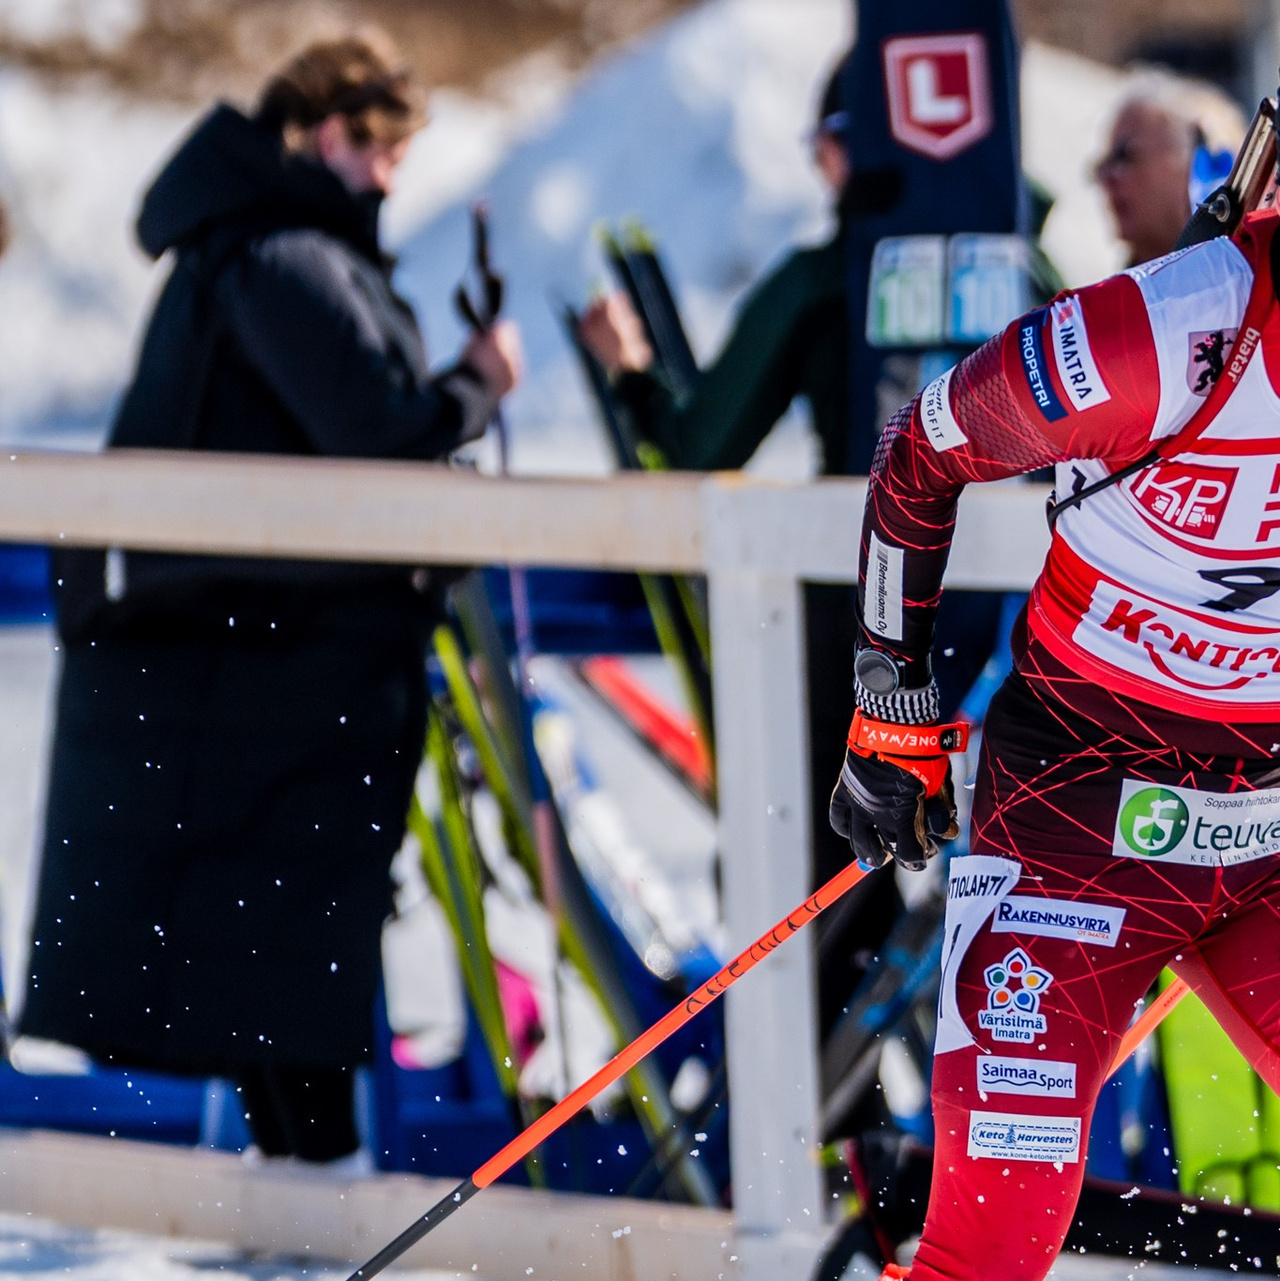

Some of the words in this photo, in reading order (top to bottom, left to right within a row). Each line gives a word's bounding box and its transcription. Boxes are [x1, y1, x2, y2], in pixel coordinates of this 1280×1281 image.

[908, 59, 967, 123] L
[1022, 326, 1050, 407] PROPETRI
[1060, 326, 1092, 399] IMATRA
[1134, 467, 1227, 528] KP
[877, 562, 888, 619] Betoniluoma
[875, 620, 888, 634] Oy
[1204, 797, 1243, 809] Soppaa
[980, 1013, 1043, 1029] Värisilmä
[995, 1029, 1031, 1040] Imatra
[982, 1063, 1037, 1080] Saimaa
[1039, 1074, 1073, 1090] Sport
[979, 1130, 1005, 1140] Keto
[1017, 1133, 1073, 1144] Harvesters
[991, 1151, 1063, 1161] www.kone-ketonen.fi
